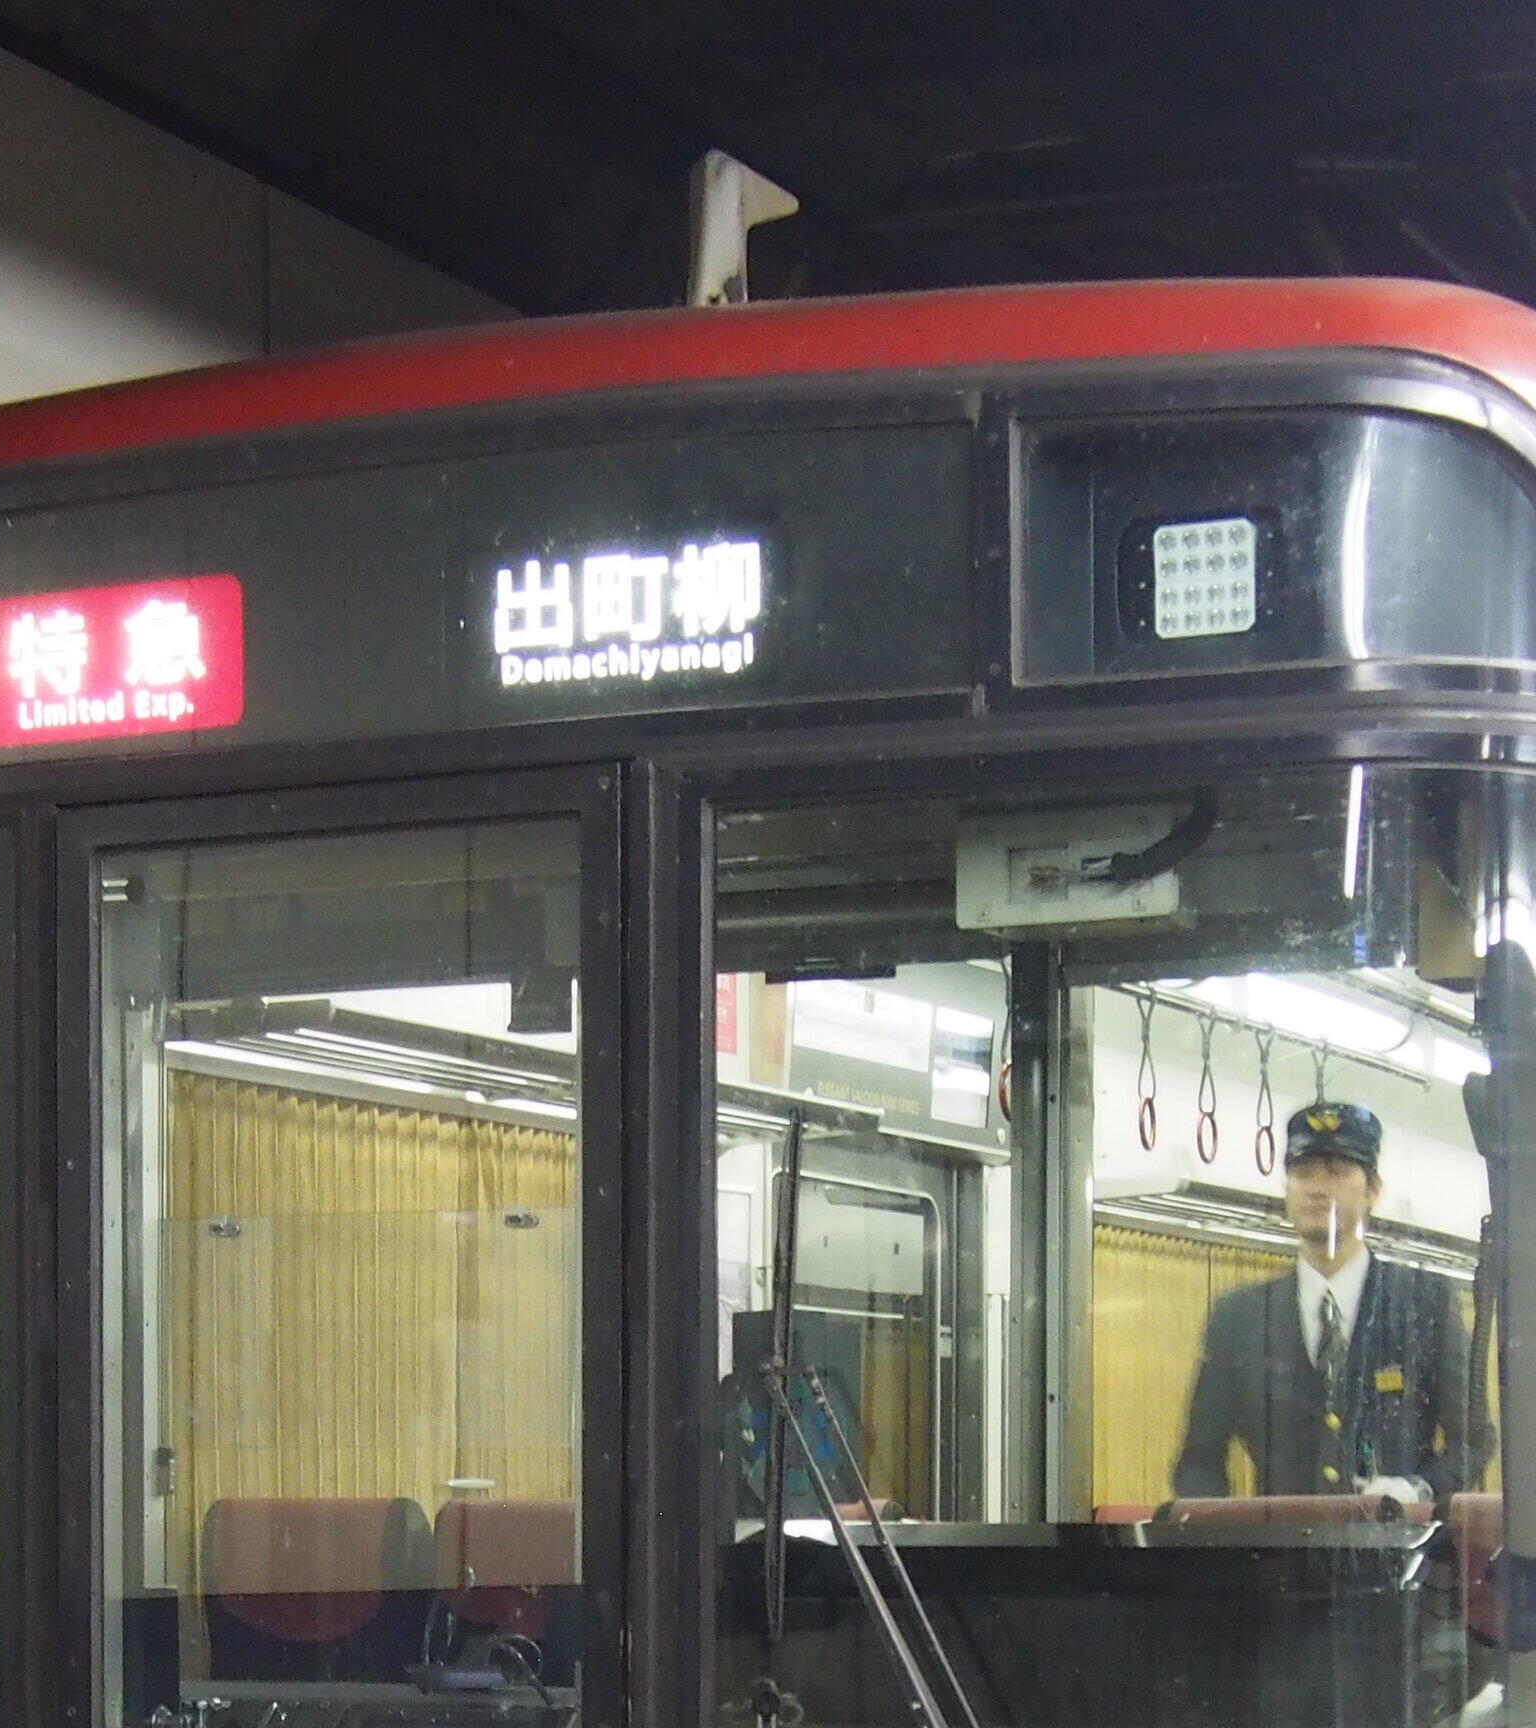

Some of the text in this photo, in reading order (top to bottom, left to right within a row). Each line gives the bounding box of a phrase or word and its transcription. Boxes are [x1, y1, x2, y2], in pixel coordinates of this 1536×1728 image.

[494, 541, 761, 654] 出町柳
[8, 600, 206, 698] 特急
[500, 631, 755, 687] Demachiyanagi
[17, 691, 195, 731] Limited Exp.
